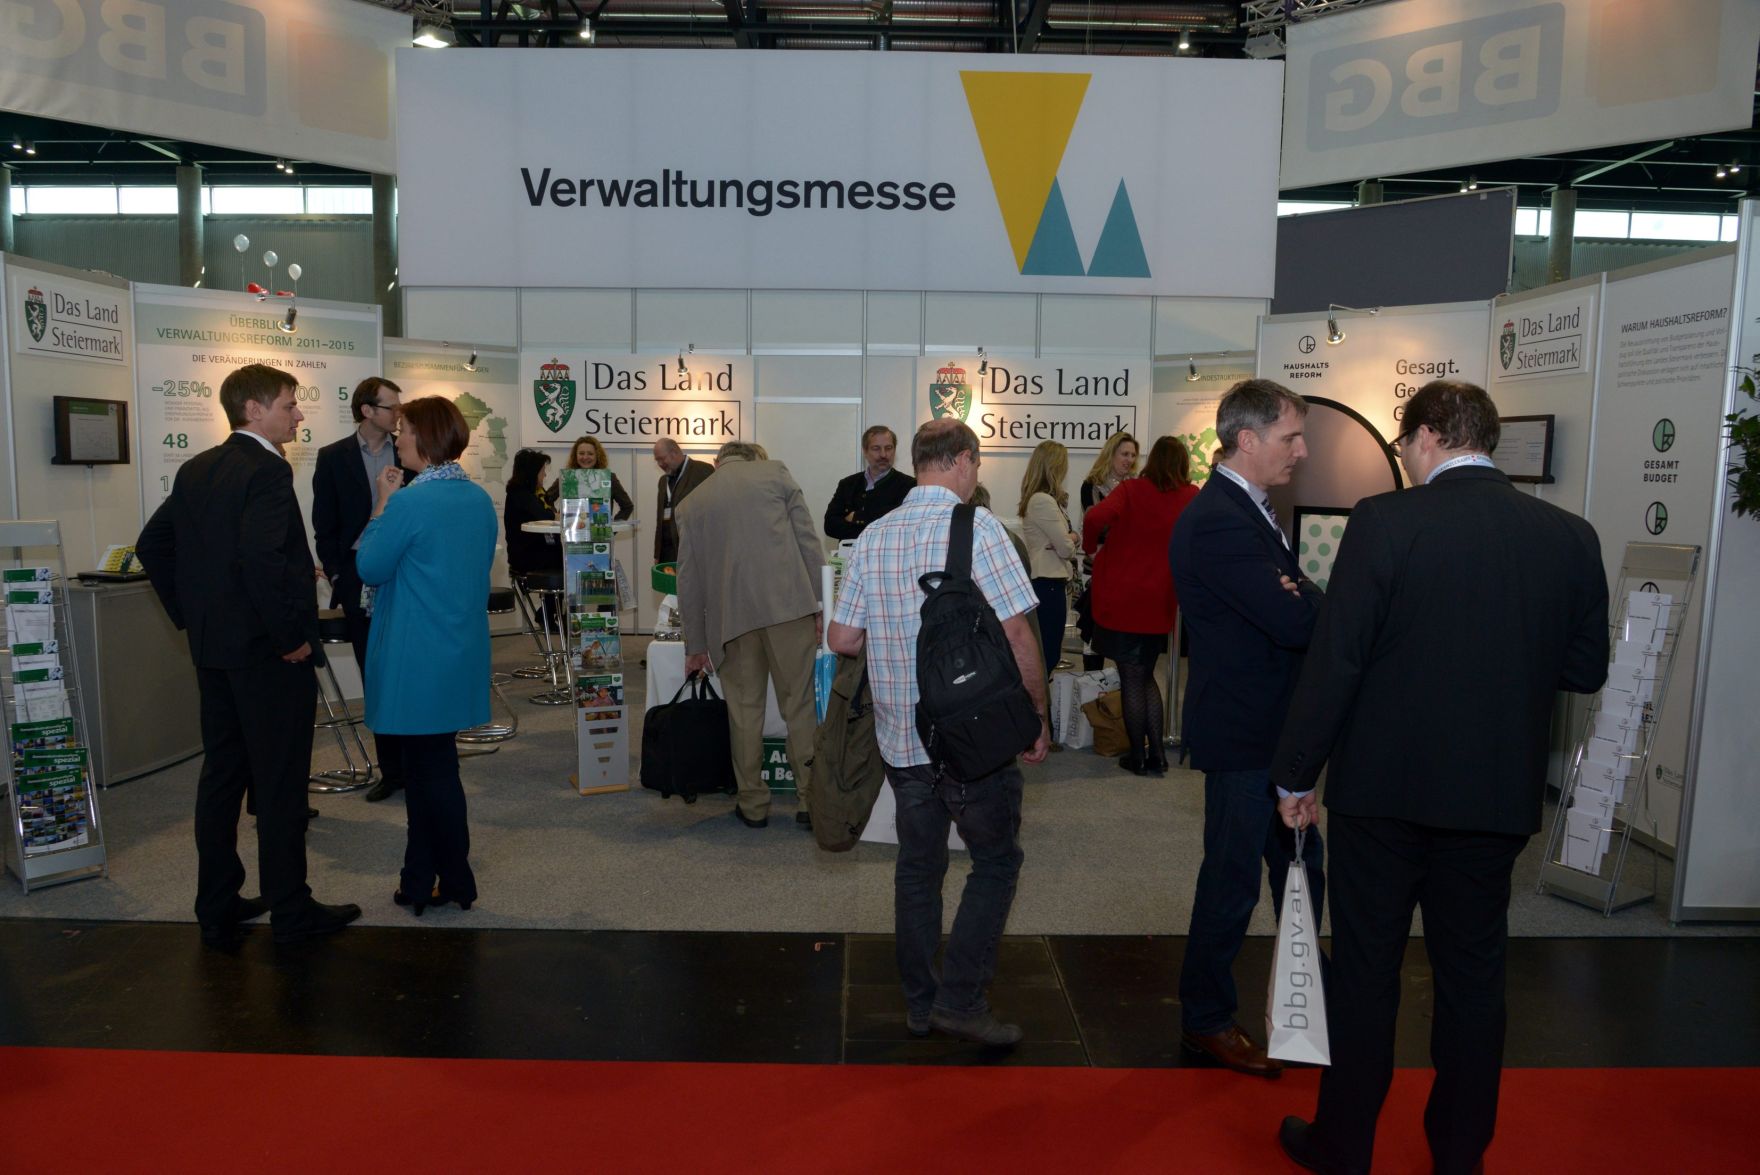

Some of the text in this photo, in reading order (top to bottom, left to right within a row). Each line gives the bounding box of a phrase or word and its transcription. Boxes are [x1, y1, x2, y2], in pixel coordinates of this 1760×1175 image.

[520, 167, 957, 217] Verwaltungsmesse
[54, 293, 119, 323] Das Land
[1522, 306, 1580, 338] Das Land
[1621, 307, 1728, 333] WARUM HAUSHALTSREFORM?
[52, 326, 120, 354] Steiermark
[156, 327, 292, 346] VERWALTUNGSREFORM
[192, 354, 327, 369] DIE VERÄNDERUNGEN IN ZAHLEN
[1283, 362, 1329, 370] HAUSHALTS
[1516, 342, 1578, 370] Steiermark
[592, 362, 733, 392] Das Land
[1396, 359, 1460, 379] Gesagt.
[989, 366, 1130, 397] Das Land
[586, 409, 735, 436] Steiermark
[981, 413, 1130, 441] Steiermark
[162, 433, 189, 449] 48
[1644, 460, 1680, 469] GESAMT
[1643, 473, 1678, 483] BUDGET
[42, 725, 68, 735] spezial
[54, 755, 80, 764] spezial
[49, 776, 75, 786] spezial
